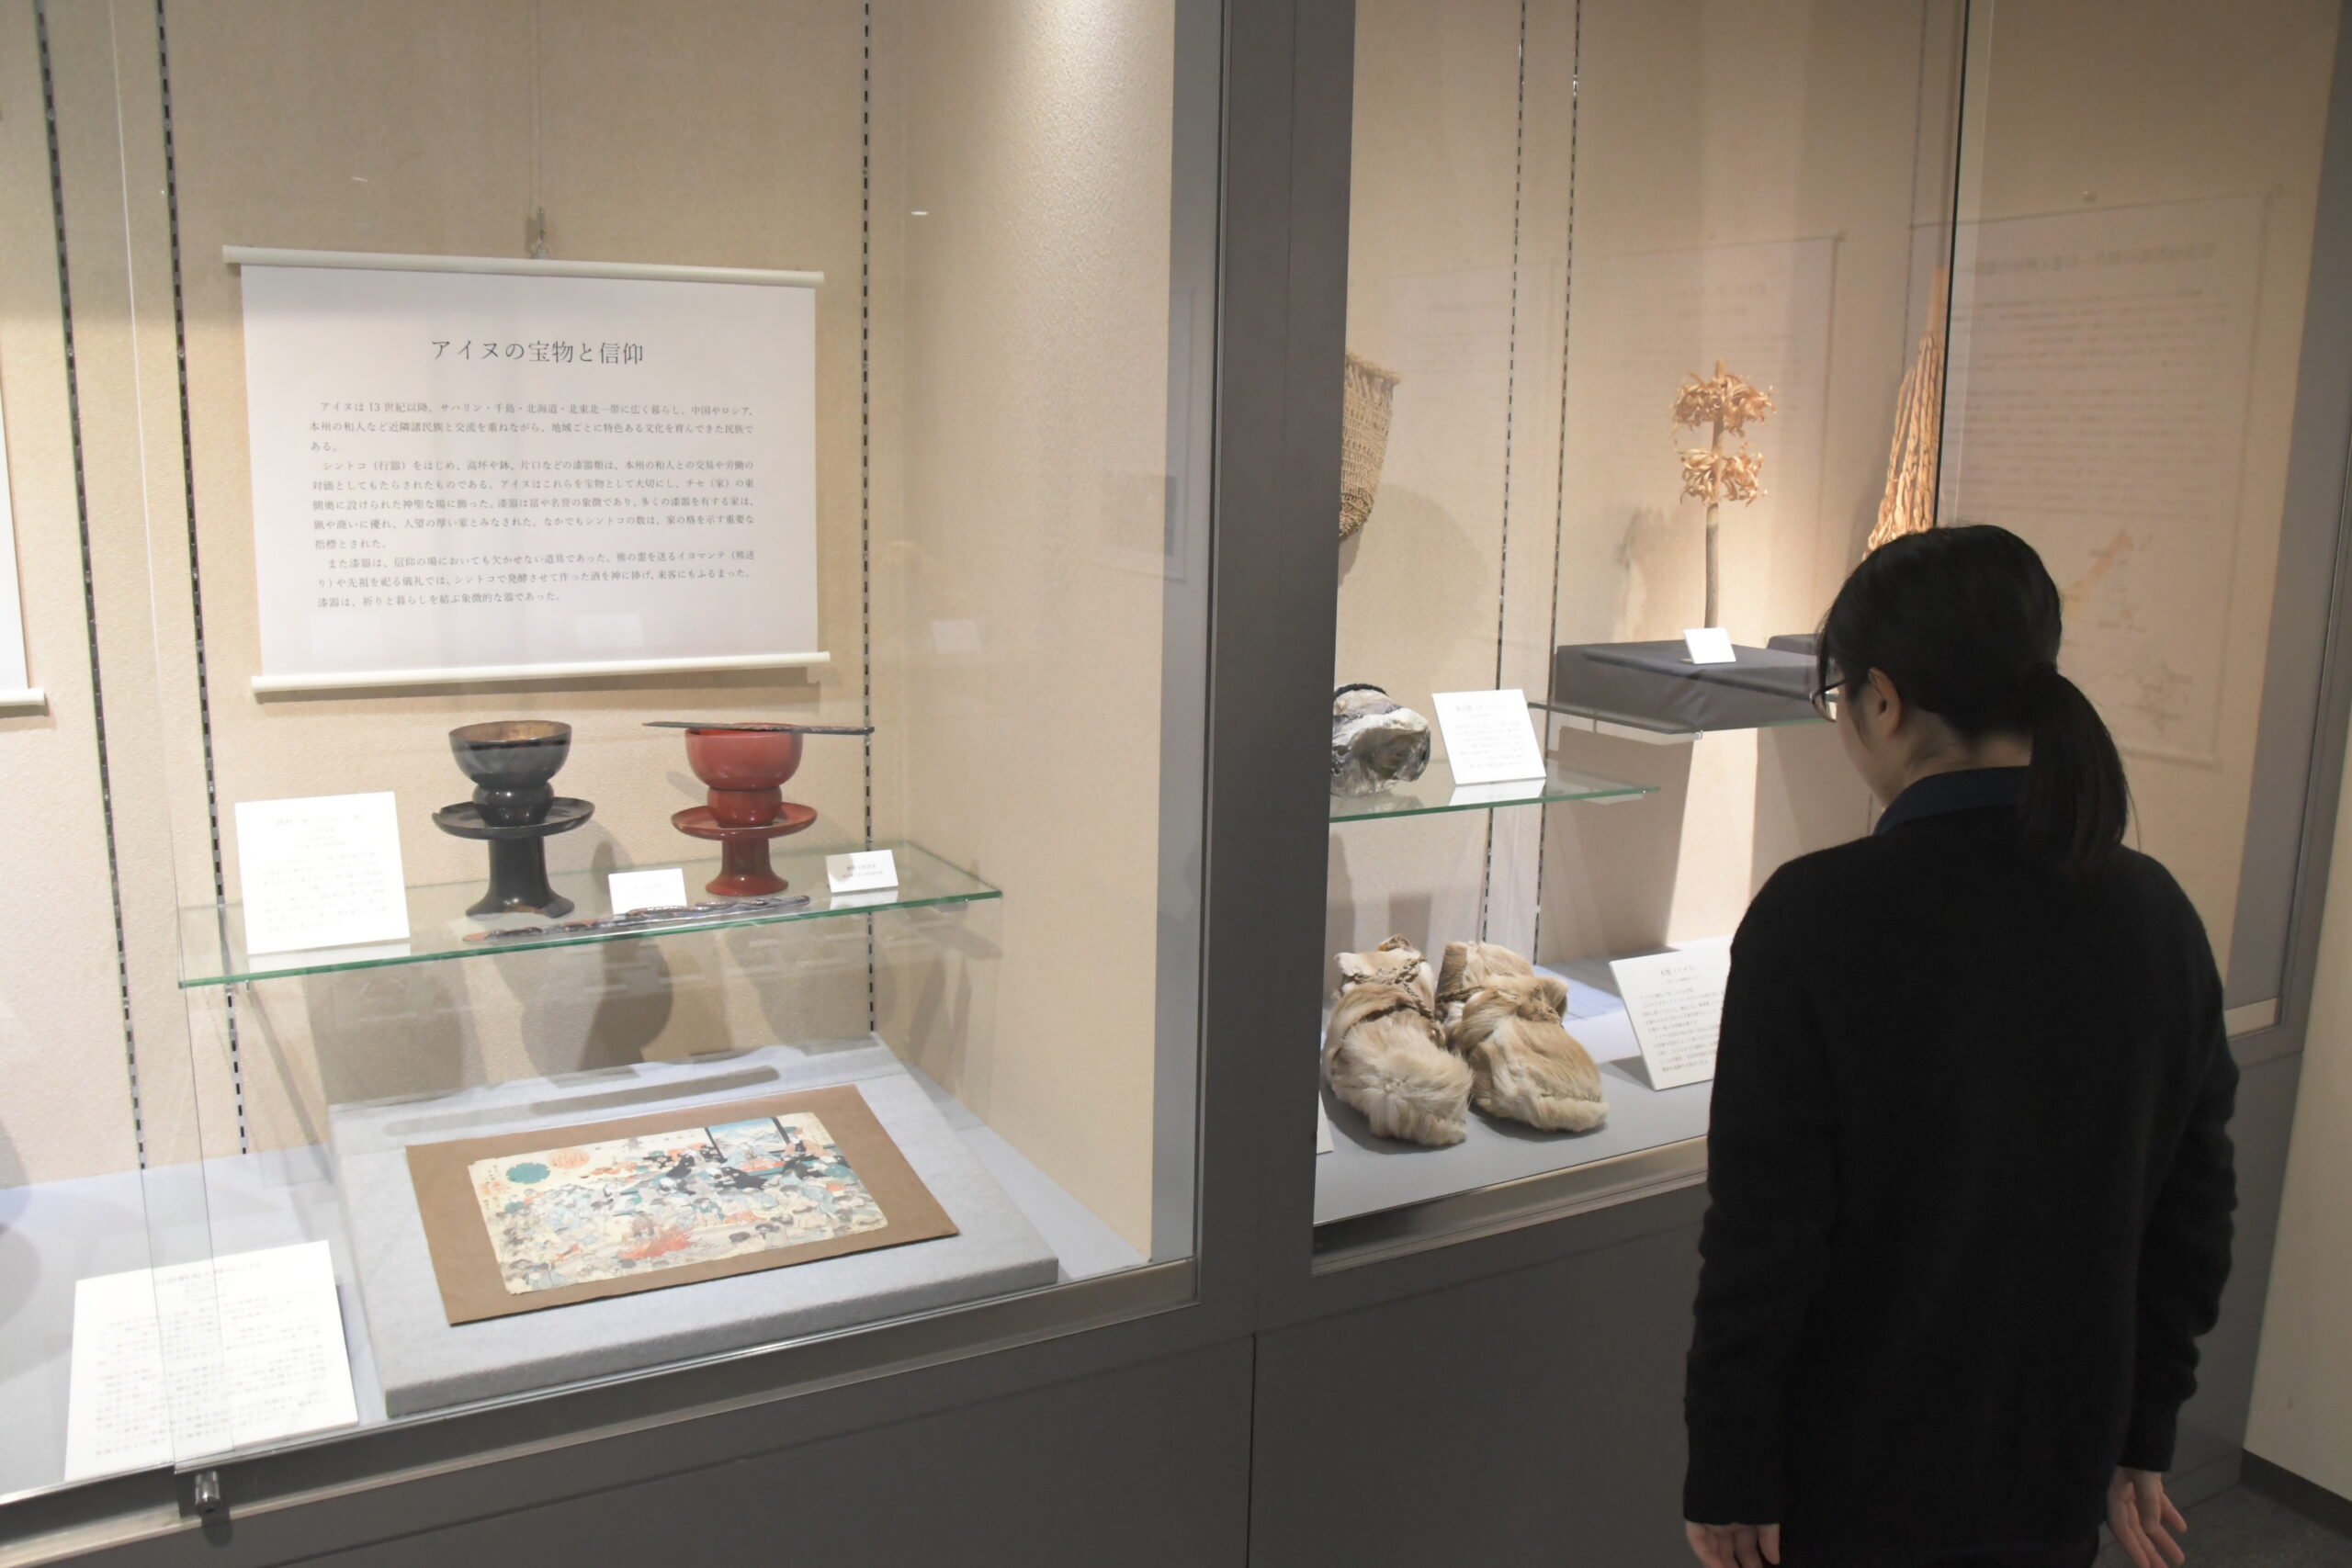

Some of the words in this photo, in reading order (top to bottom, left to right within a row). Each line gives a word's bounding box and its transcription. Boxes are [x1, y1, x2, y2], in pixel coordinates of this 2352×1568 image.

[432, 340, 644, 365] アイヌの宝物と信仰
[310, 441, 337, 453] ある。
[315, 538, 387, 550] 指標とされた。
[317, 592, 560, 608] 漆器は、祈りと暮らしを結ぶ象徴的な器であった。
